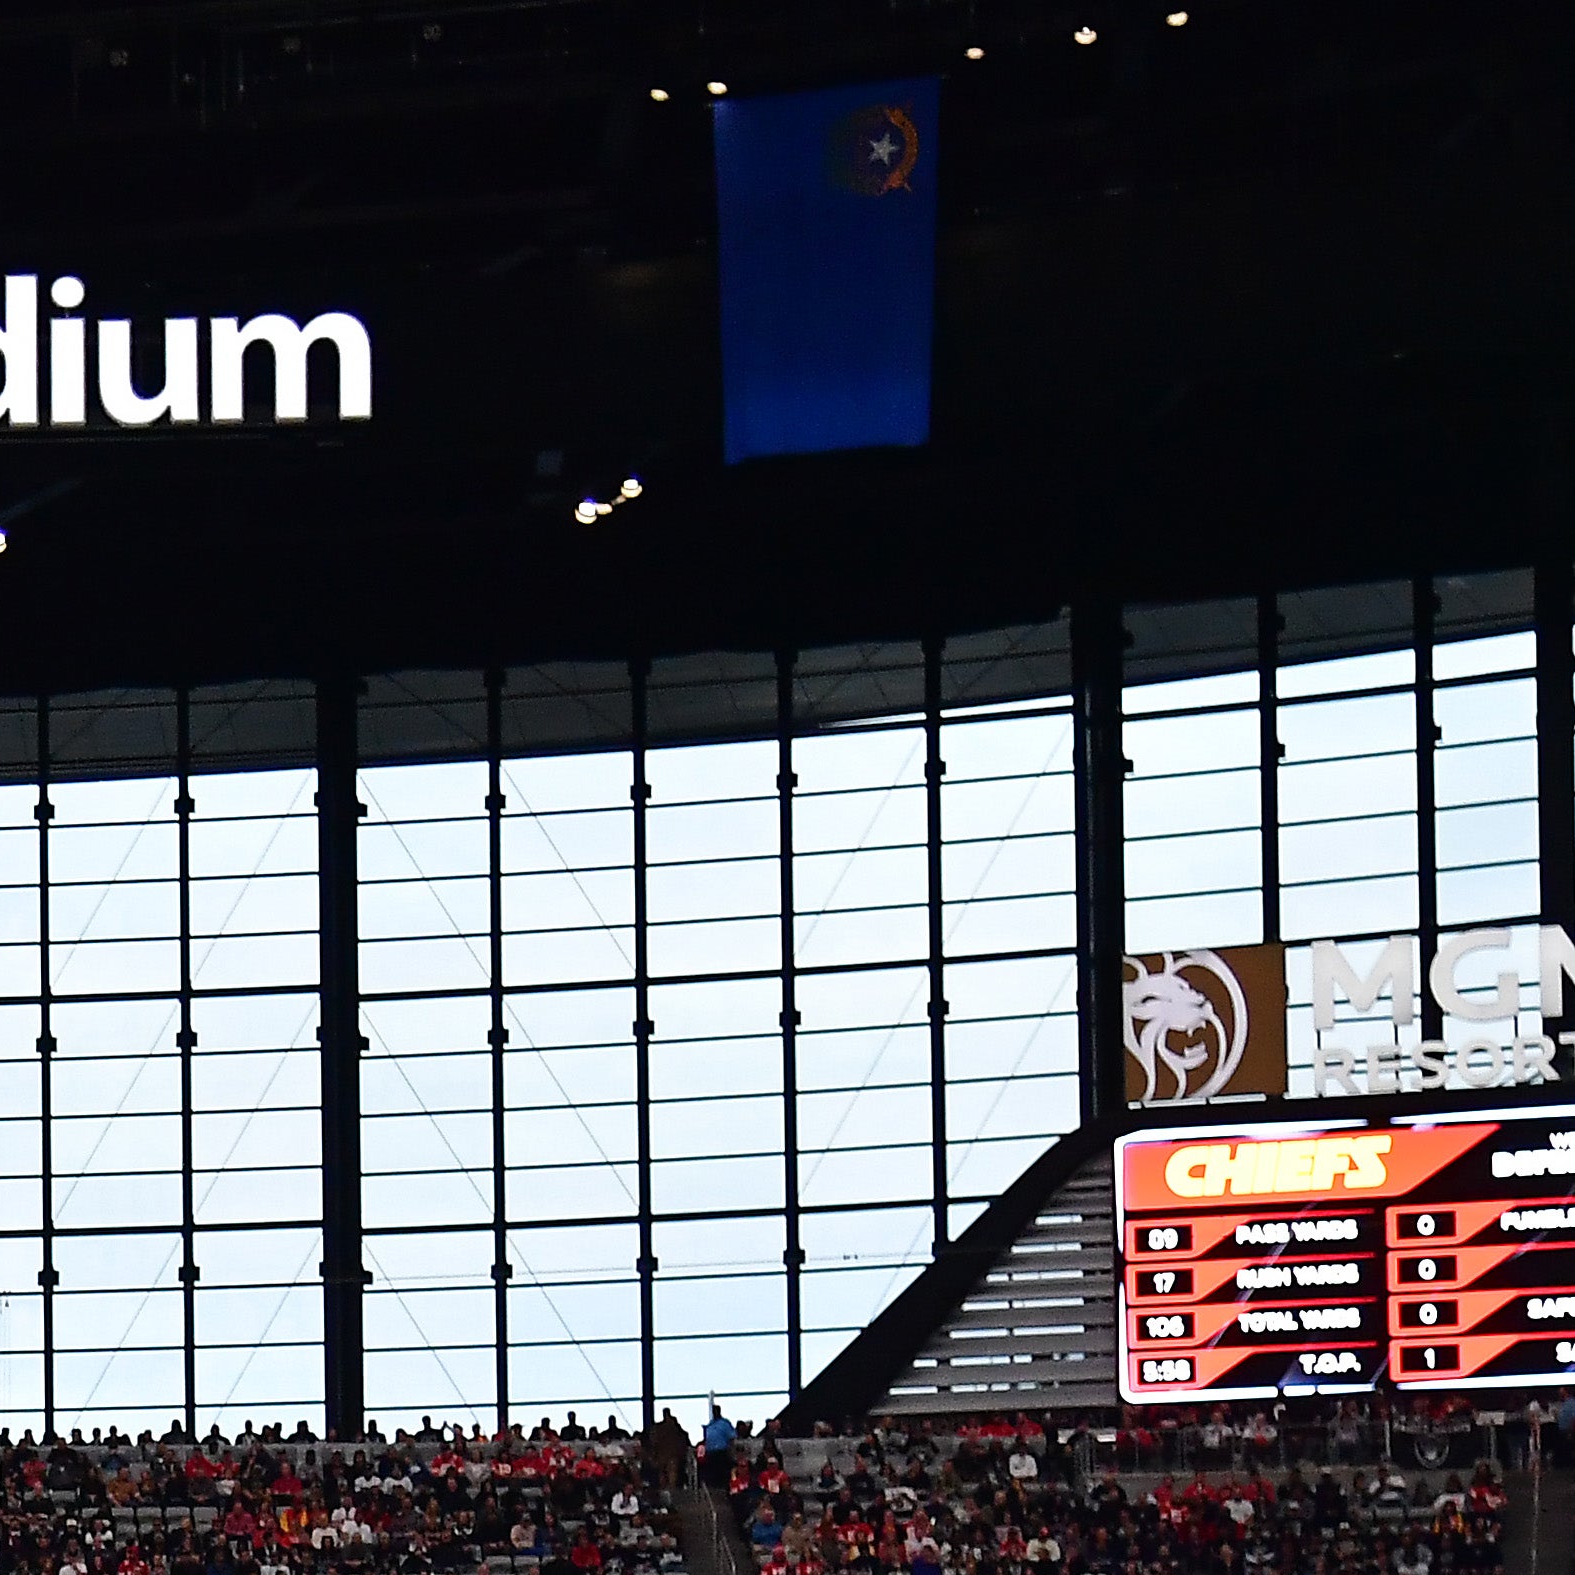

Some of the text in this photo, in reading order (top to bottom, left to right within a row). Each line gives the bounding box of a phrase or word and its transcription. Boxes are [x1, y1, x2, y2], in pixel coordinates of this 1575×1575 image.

[1165, 1134, 1392, 1198] CHIEFS
[1417, 1214, 1435, 1236] 0
[1418, 1259, 1436, 1280] 0
[1153, 1272, 1175, 1293] 17
[1419, 1303, 1437, 1324] 0
[1424, 1348, 1435, 1369] 1
